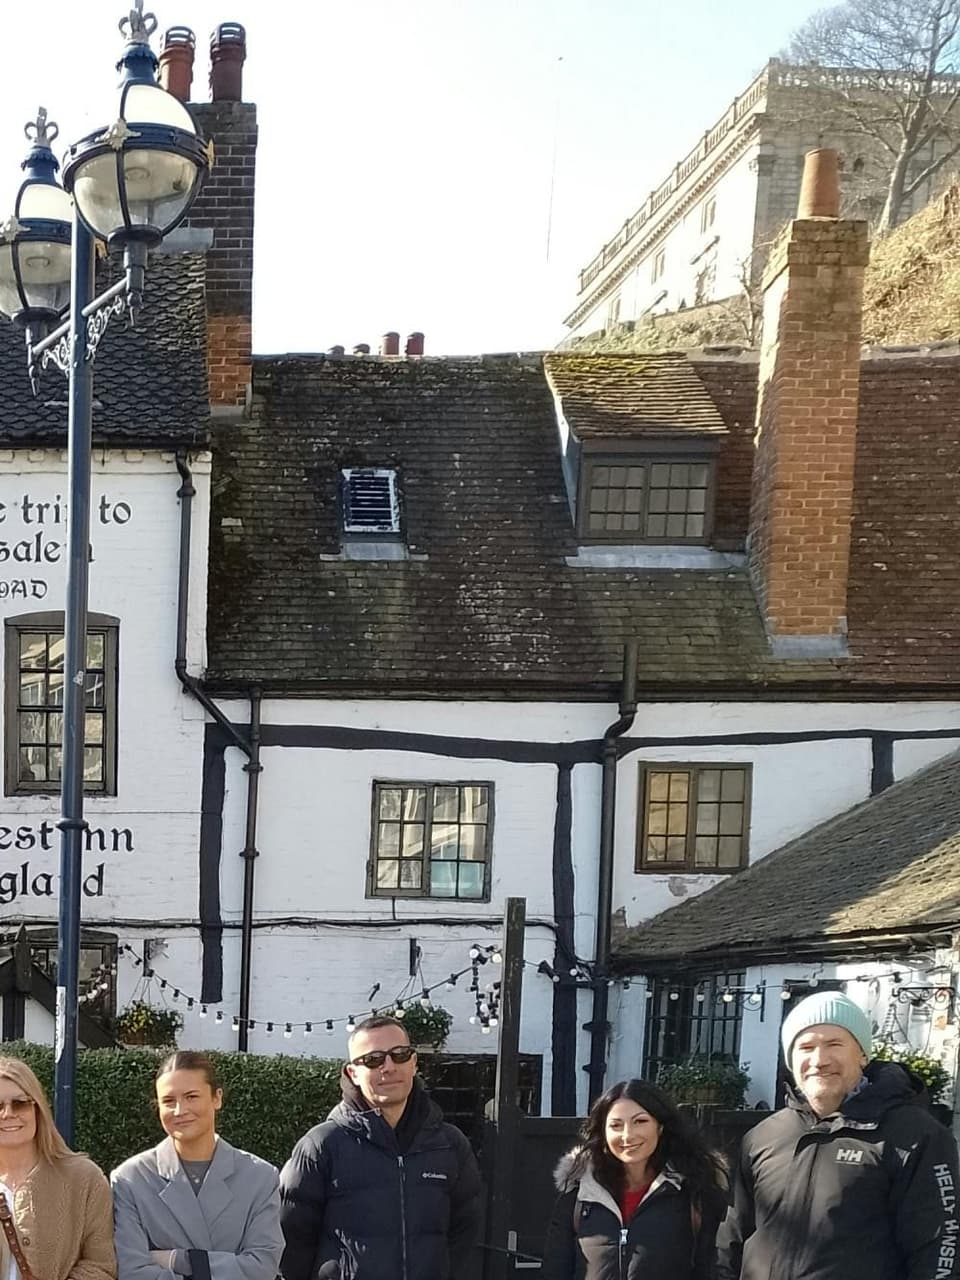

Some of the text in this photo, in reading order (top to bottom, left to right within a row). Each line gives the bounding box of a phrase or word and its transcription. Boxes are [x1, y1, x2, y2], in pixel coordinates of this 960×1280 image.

[21, 494, 68, 532] tri
[99, 495, 132, 525] to
[83, 826, 135, 851] nn
[836, 1148, 863, 1162] HH
[933, 1163, 960, 1280] HELLY HNSEN
